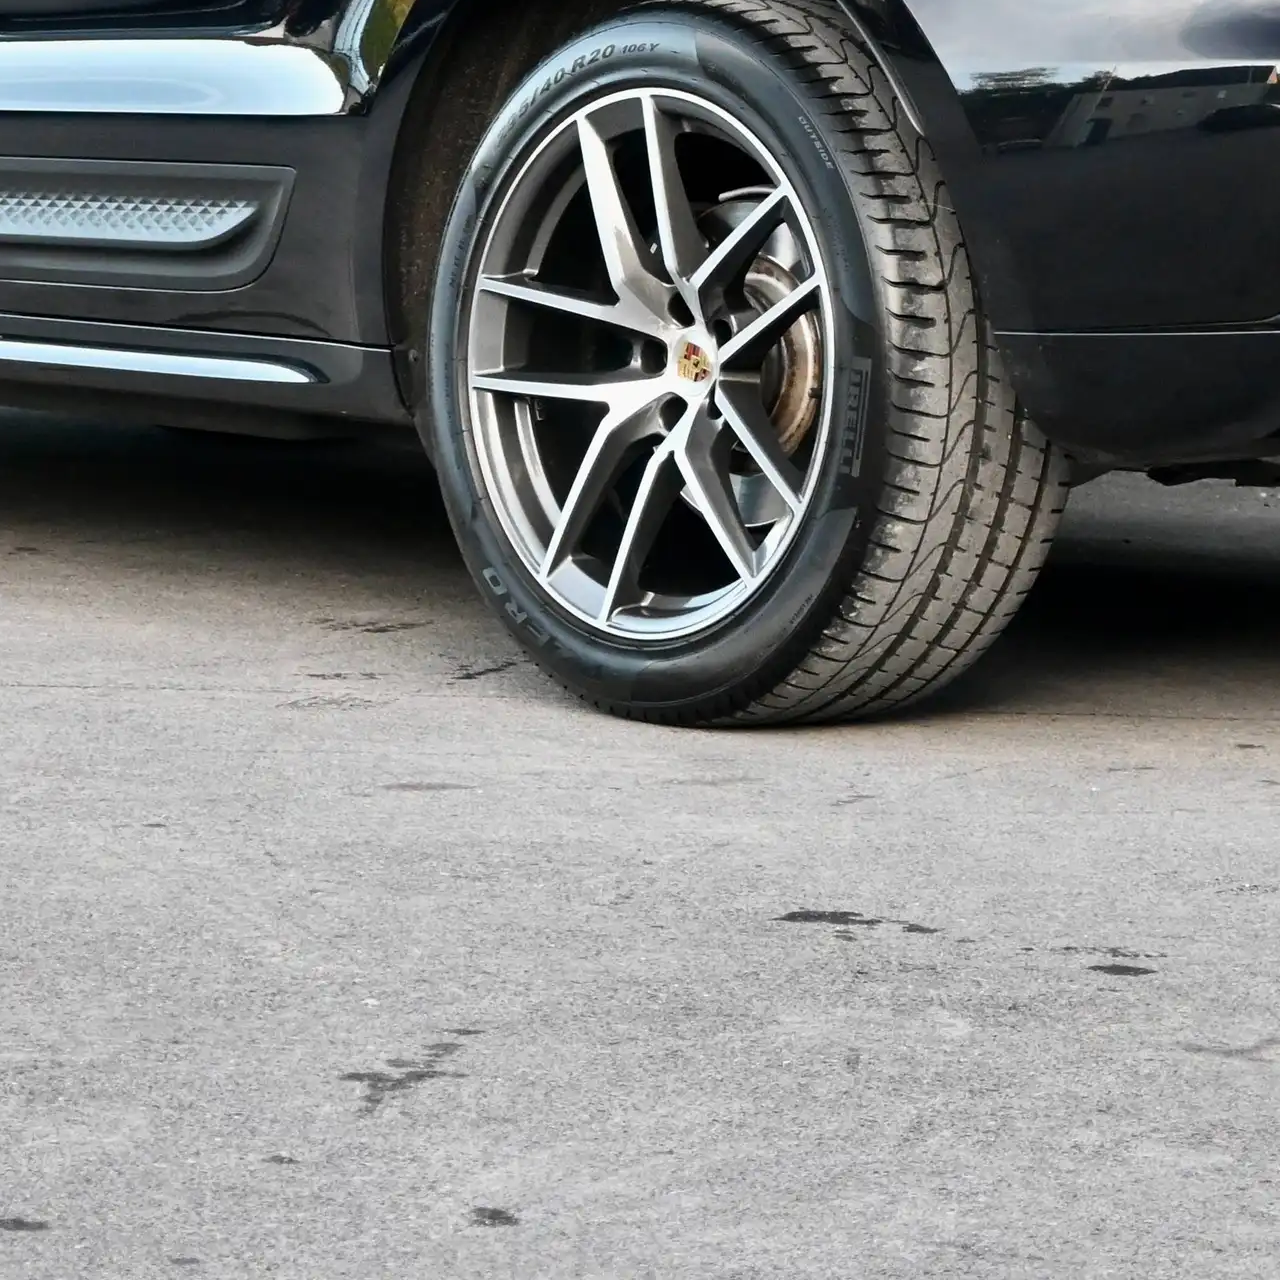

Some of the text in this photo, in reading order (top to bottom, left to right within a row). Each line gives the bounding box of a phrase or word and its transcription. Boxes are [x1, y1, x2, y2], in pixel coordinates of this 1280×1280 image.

[571, 44, 616, 73] R20
[798, 116, 835, 170] OUTSIDE
[839, 356, 872, 477] PIRELLI
